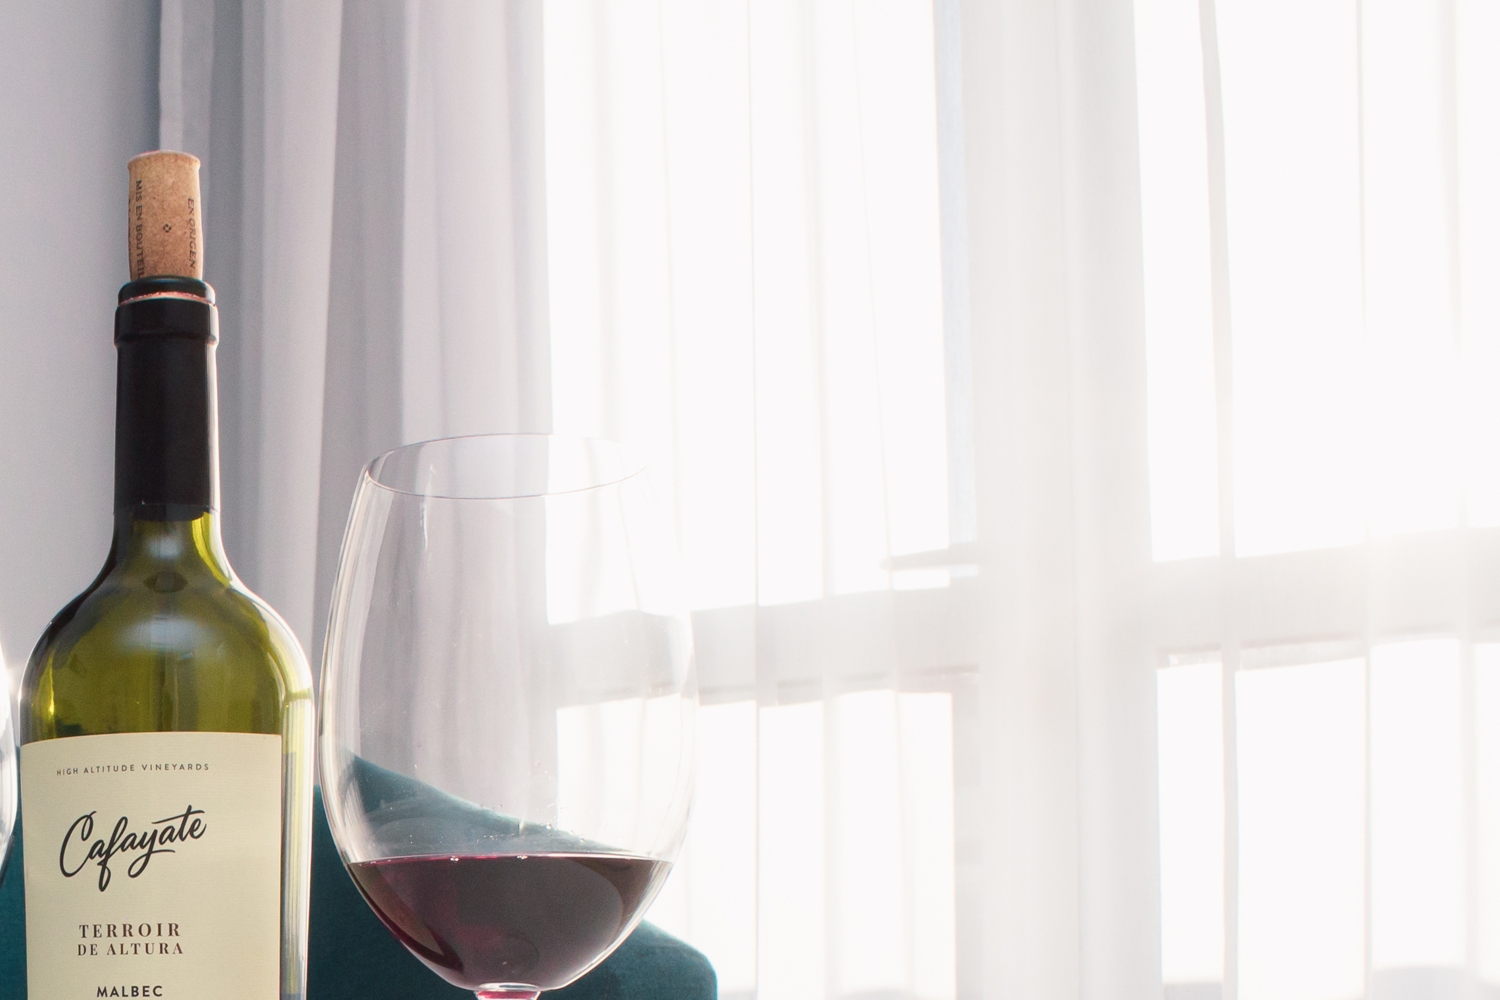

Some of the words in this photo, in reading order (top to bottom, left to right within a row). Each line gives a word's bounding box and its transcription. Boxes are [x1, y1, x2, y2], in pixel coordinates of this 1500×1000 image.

[135, 180, 143, 202] MIS
[135, 205, 143, 222] EN
[188, 198, 194, 215] EN
[188, 217, 197, 268] ORIGEN
[56, 768, 79, 776] HIGH
[83, 763, 136, 774] ALTITUDE
[141, 763, 210, 772] VINEYARDS
[59, 804, 207, 892] Cafayate
[78, 922, 181, 939] TERROIR
[77, 943, 98, 956] DE
[106, 942, 184, 956] ALTURA
[96, 985, 164, 998] MALBEC
